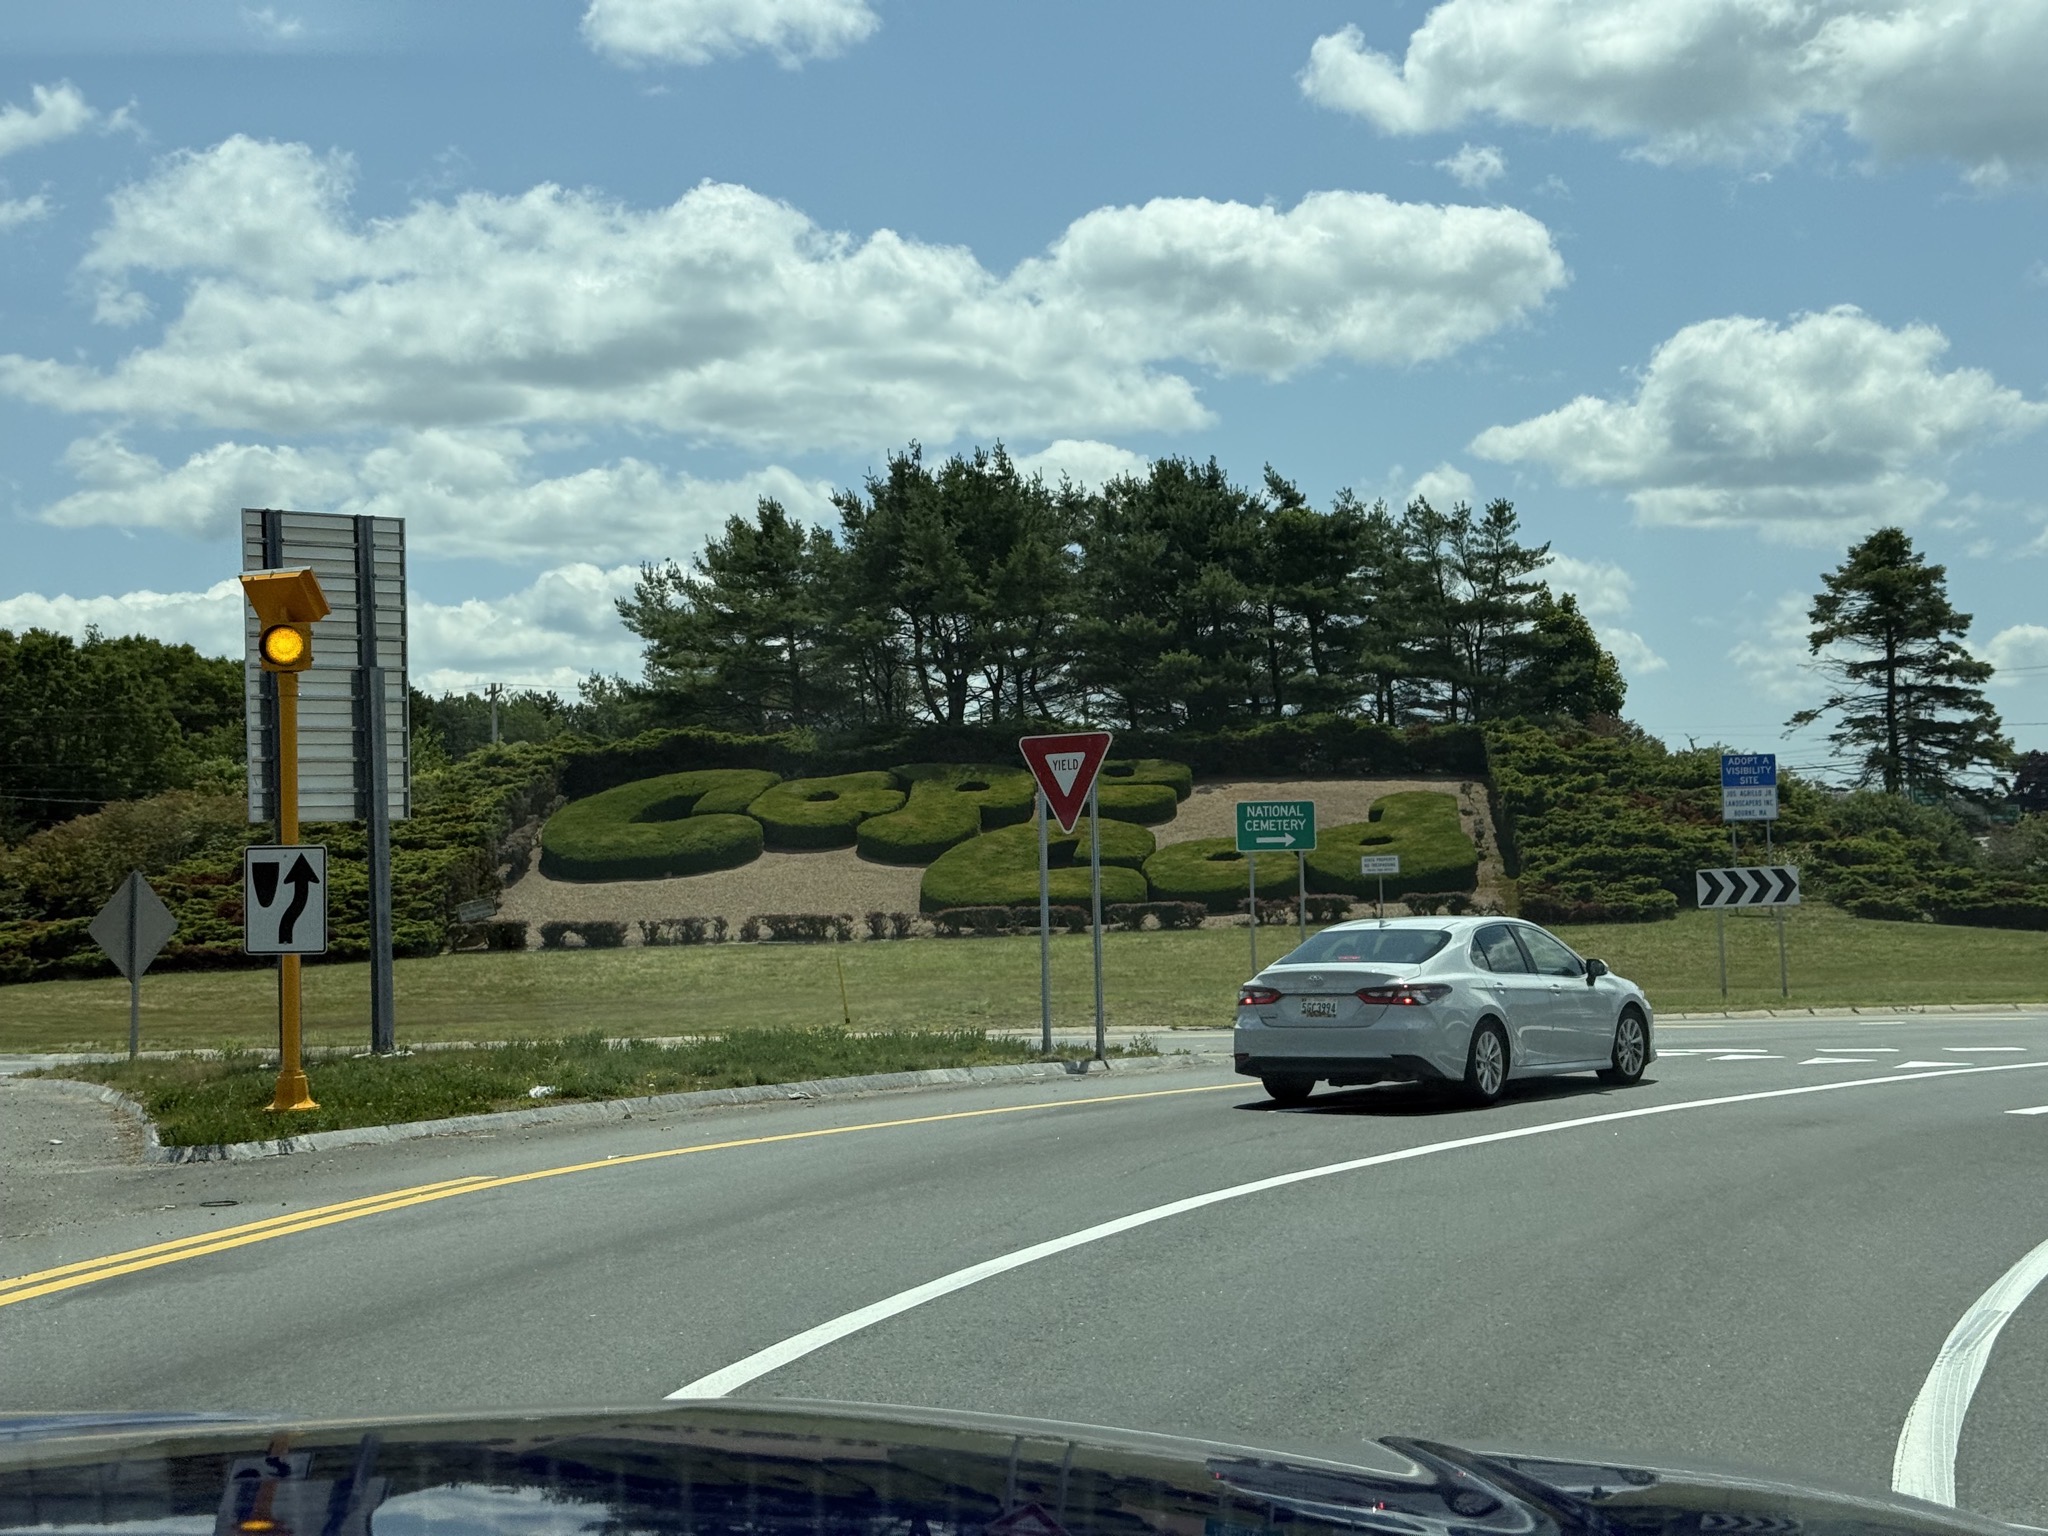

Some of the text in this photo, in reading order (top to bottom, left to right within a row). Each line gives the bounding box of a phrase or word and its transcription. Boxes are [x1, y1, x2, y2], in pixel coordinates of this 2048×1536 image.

[1052, 758, 1079, 771] YIELD
[1727, 757, 1770, 766] ADOPT A
[1725, 766, 1772, 776] VISIBILITY
[1739, 776, 1760, 785] SITE
[1725, 799, 1762, 807] LANDSCAPERS
[1246, 805, 1305, 818] NATIONAL
[1245, 818, 1307, 831] CEMETERY
